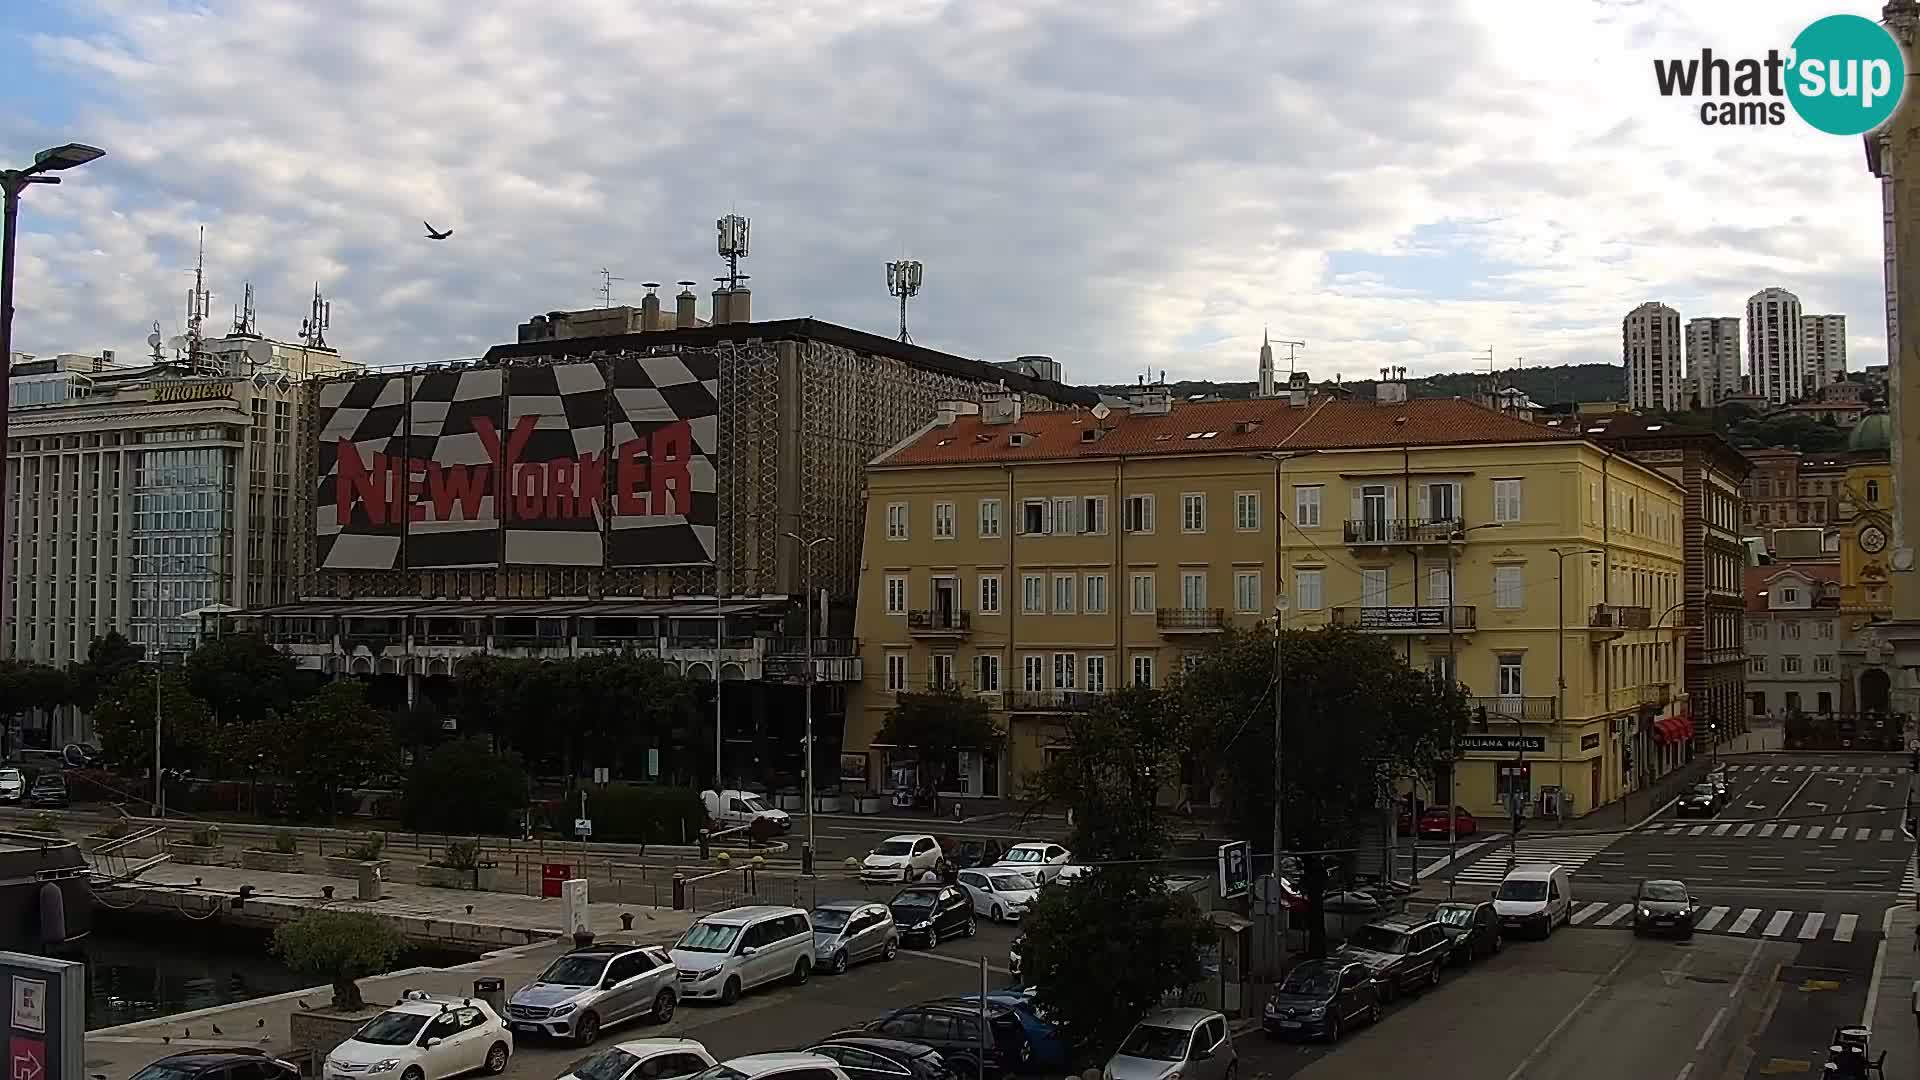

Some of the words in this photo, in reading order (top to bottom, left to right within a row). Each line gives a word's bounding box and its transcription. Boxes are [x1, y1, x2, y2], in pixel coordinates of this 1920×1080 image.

[337, 436, 488, 527] NEW
[471, 414, 693, 521] YORKER
[1507, 739, 1539, 749] NAILS
